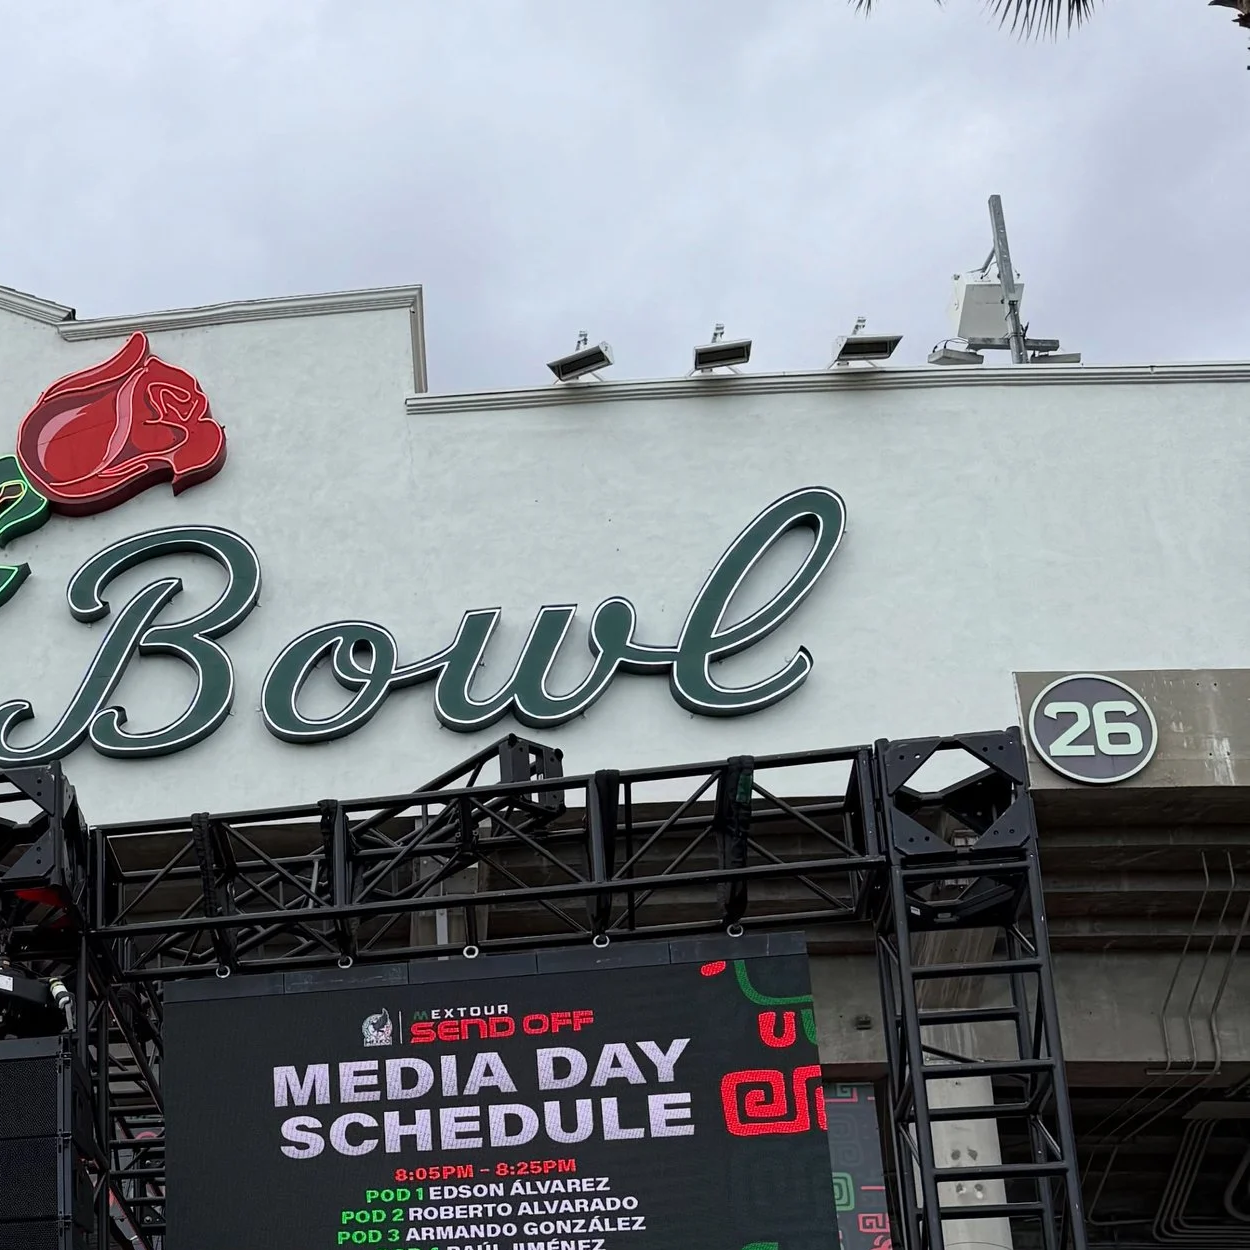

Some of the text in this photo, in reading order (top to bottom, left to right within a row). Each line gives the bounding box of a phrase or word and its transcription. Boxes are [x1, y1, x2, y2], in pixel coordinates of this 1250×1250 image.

[1047, 701, 1143, 757] 26
[411, 1004, 509, 1022] MEXTOUR
[411, 1010, 593, 1043] SEND OFF
[274, 1038, 690, 1107] MEDIA DAY
[279, 1092, 695, 1160] SCHEDULE
[395, 1165, 473, 1181] 8:05PM
[496, 1159, 576, 1175] 8:25PM
[366, 1177, 610, 1203] POD 1 EDSON ÁLVAREZ
[338, 1216, 646, 1244] POD 3 ARMANDO GONZÁLEZ
